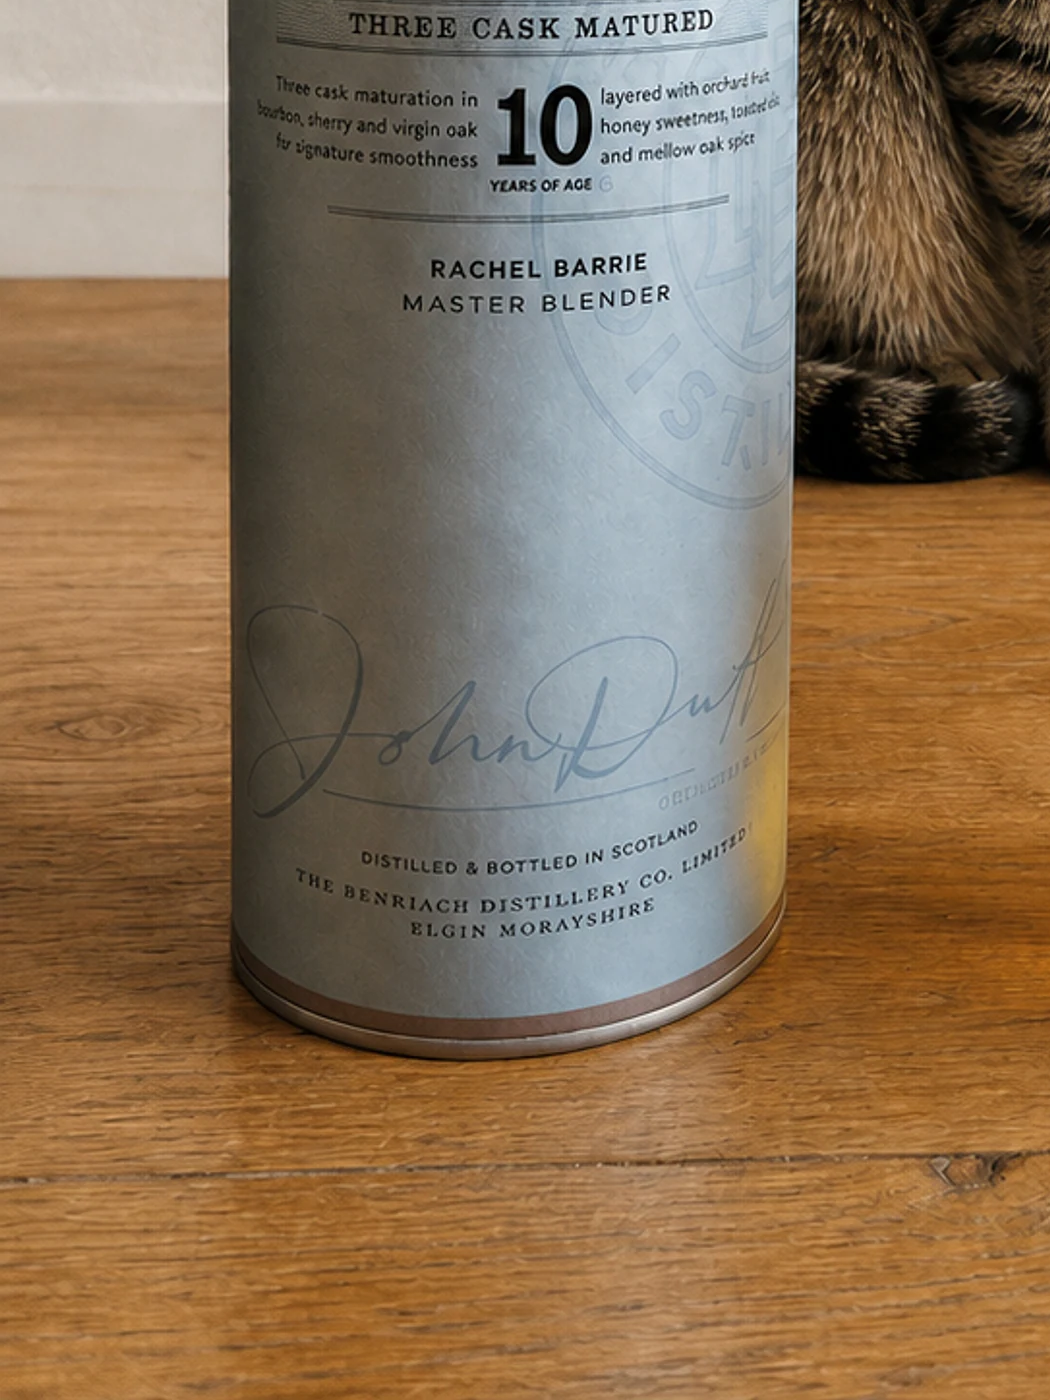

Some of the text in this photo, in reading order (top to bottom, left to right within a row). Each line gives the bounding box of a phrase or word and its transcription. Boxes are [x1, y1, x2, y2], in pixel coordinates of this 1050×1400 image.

[349, 9, 714, 40] THREE CASK MATURED
[276, 75, 478, 108] Three cask maturation in
[601, 85, 661, 110] layered
[667, 81, 699, 100] with
[308, 112, 353, 136] sherry
[357, 118, 387, 135] and
[392, 119, 439, 141] virgin
[446, 122, 478, 138] oak
[497, 84, 593, 166] 10
[601, 117, 651, 139] honey
[296, 139, 364, 163] signature
[369, 150, 478, 169] smoothness
[601, 146, 632, 165] and
[638, 141, 696, 162] mellow
[700, 139, 724, 155] oak
[489, 178, 592, 193] YEARS OF AGE
[430, 253, 648, 279] RACHEL BARRIE
[403, 284, 671, 314] MASTER BLENDER
[361, 820, 698, 875] DISTILLED & BOTTLED IN SCOTLAND
[296, 826, 748, 915] THE BENRIACH DISTILLERY CO. LIMITED
[410, 898, 655, 939] ELGIN MORAYSHIRE
